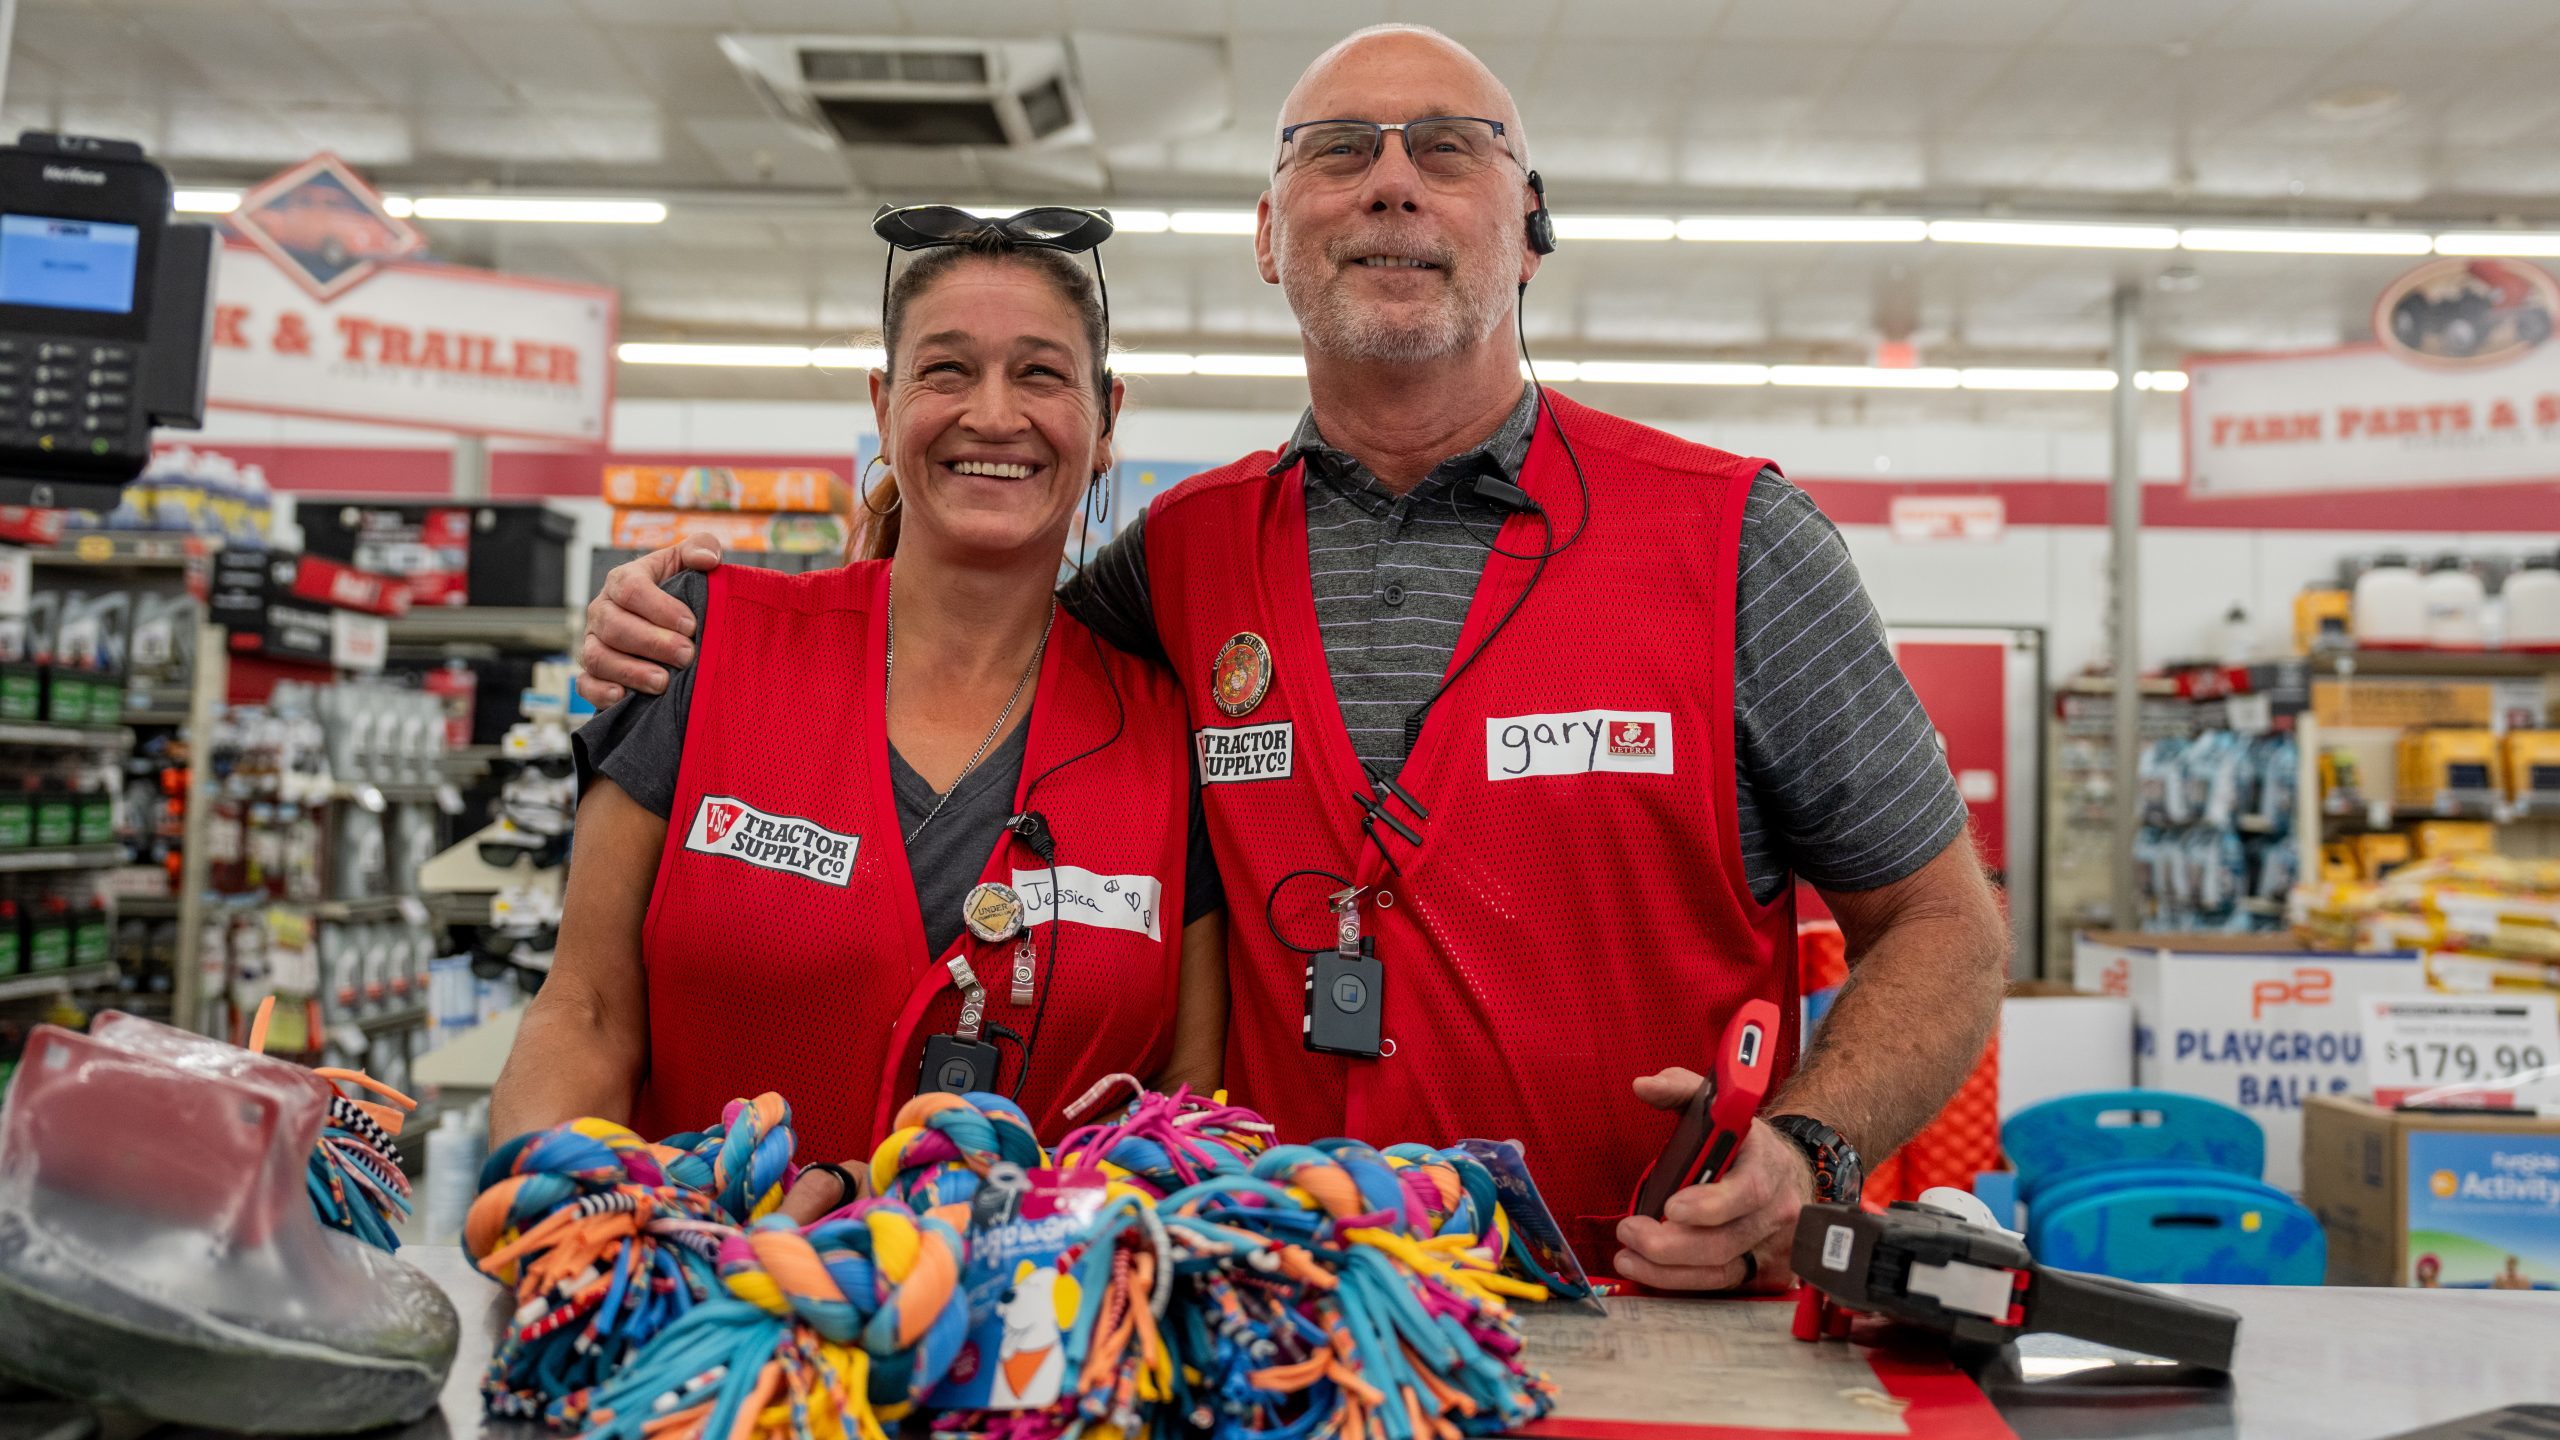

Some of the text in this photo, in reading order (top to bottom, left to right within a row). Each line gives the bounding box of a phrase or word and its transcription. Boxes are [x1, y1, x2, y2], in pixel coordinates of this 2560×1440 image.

[272, 311, 310, 357] &
[336, 314, 580, 387] TRAILER
[2211, 410, 2322, 447] FARM
[2336, 401, 2472, 439] PARTS
[1213, 635, 1268, 670] UNITED STATES
[1212, 677, 1266, 714] MARINE CORPS
[1203, 729, 1287, 755] TRACTOR
[1501, 718, 1604, 775] gary
[1610, 746, 1655, 755] VETERAN
[707, 805, 732, 837] TSC
[743, 812, 849, 860] TRACTOR
[730, 831, 819, 871] SUPPLY
[978, 902, 1009, 916] UNDER
[1021, 880, 1104, 913] Jessica
